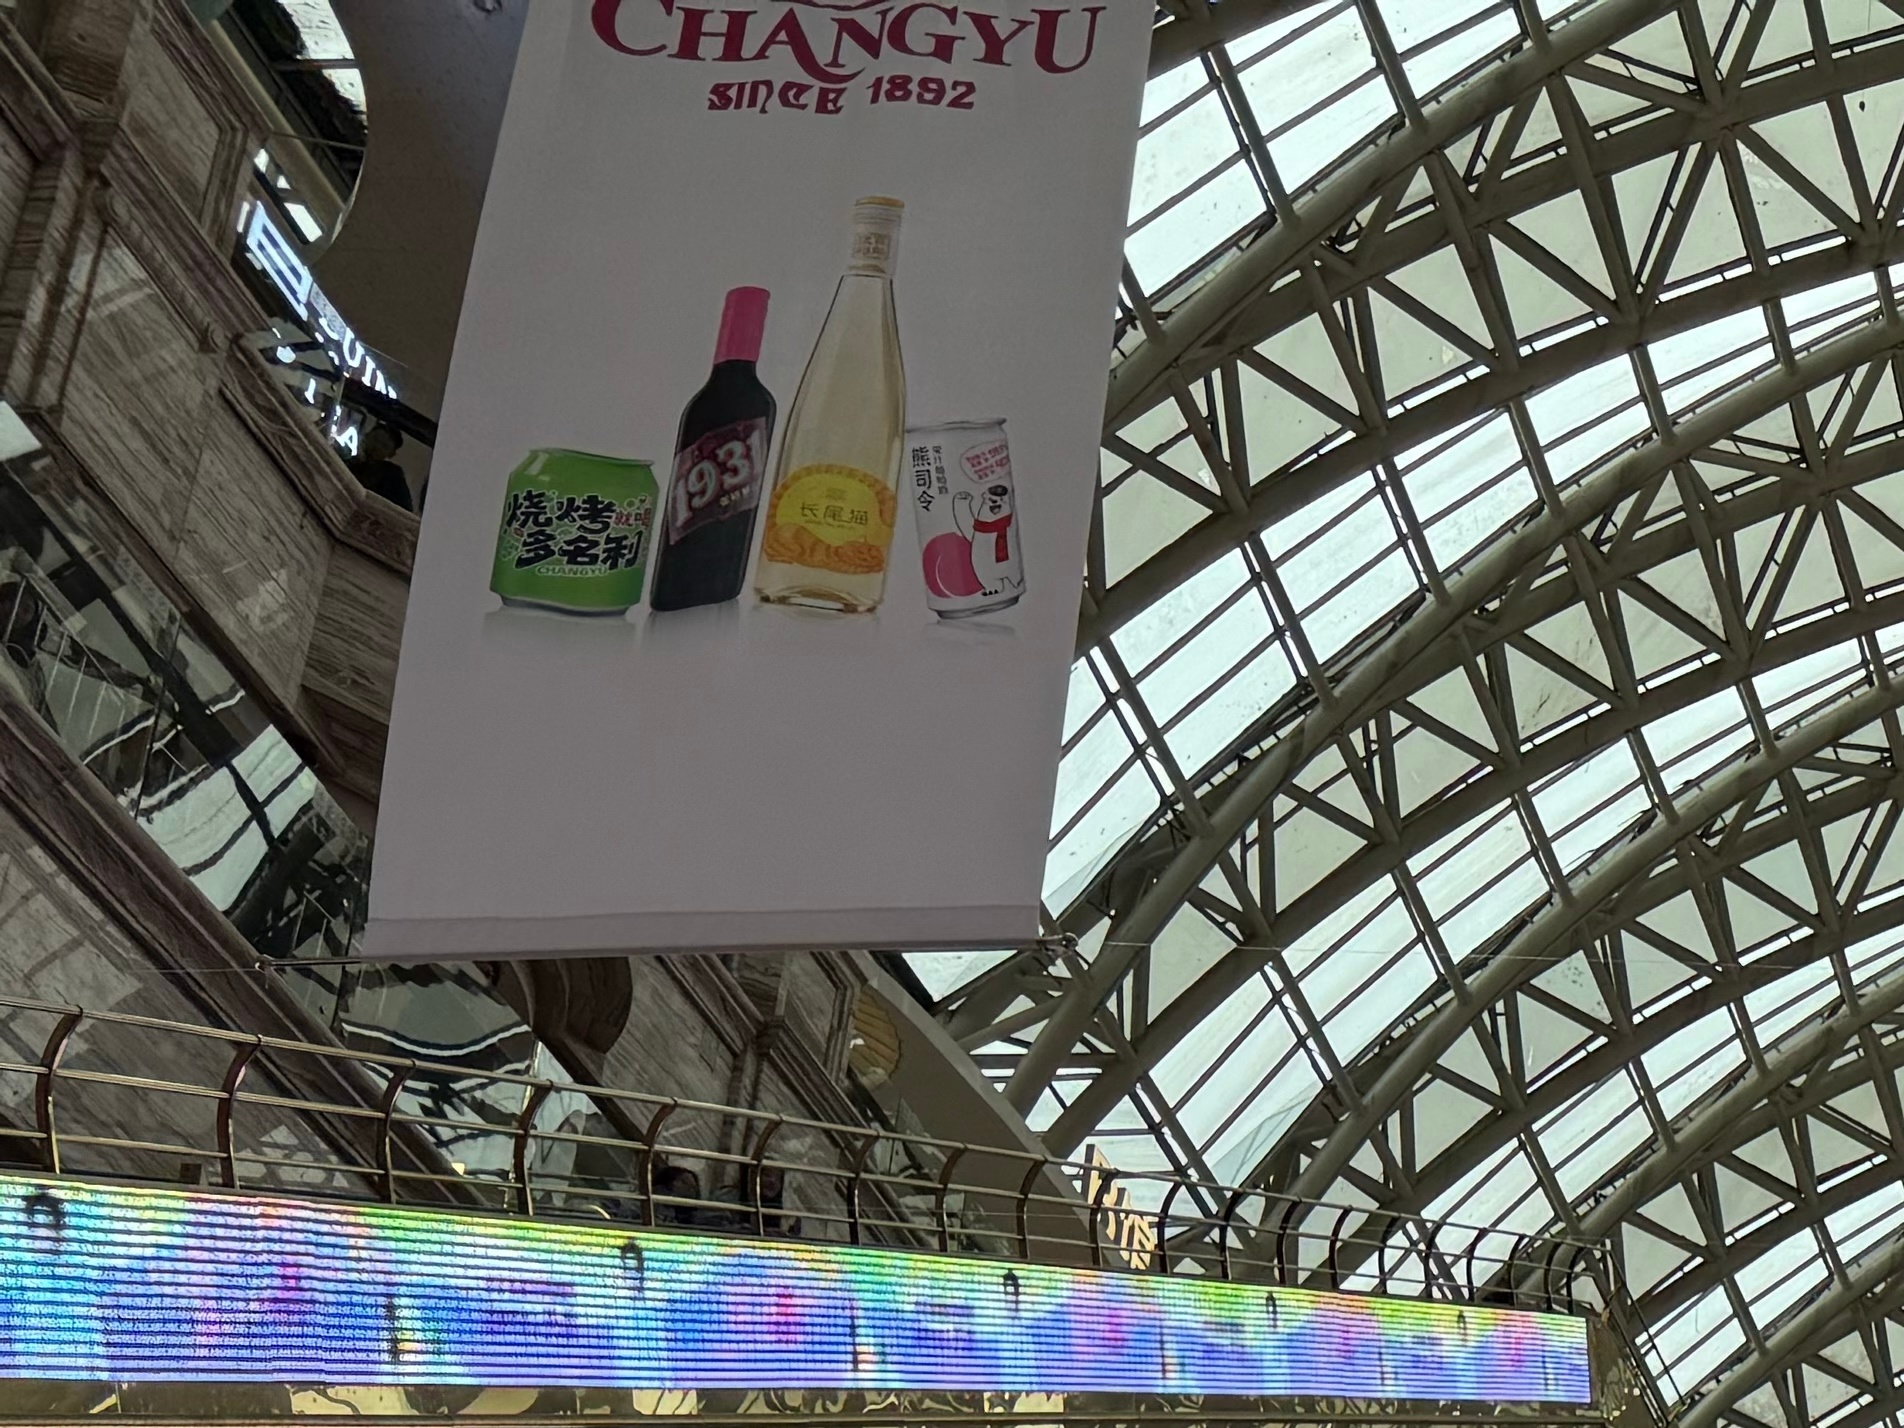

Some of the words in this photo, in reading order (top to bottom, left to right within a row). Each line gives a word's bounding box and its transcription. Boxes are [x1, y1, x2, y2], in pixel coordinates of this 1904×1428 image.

[590, 0, 1106, 85] CHANGYU
[868, 74, 977, 110] 1892
[670, 430, 766, 529] 1931
[912, 445, 935, 513] 熊司令
[506, 489, 617, 534] 烧烤
[515, 529, 643, 571] 多名利
